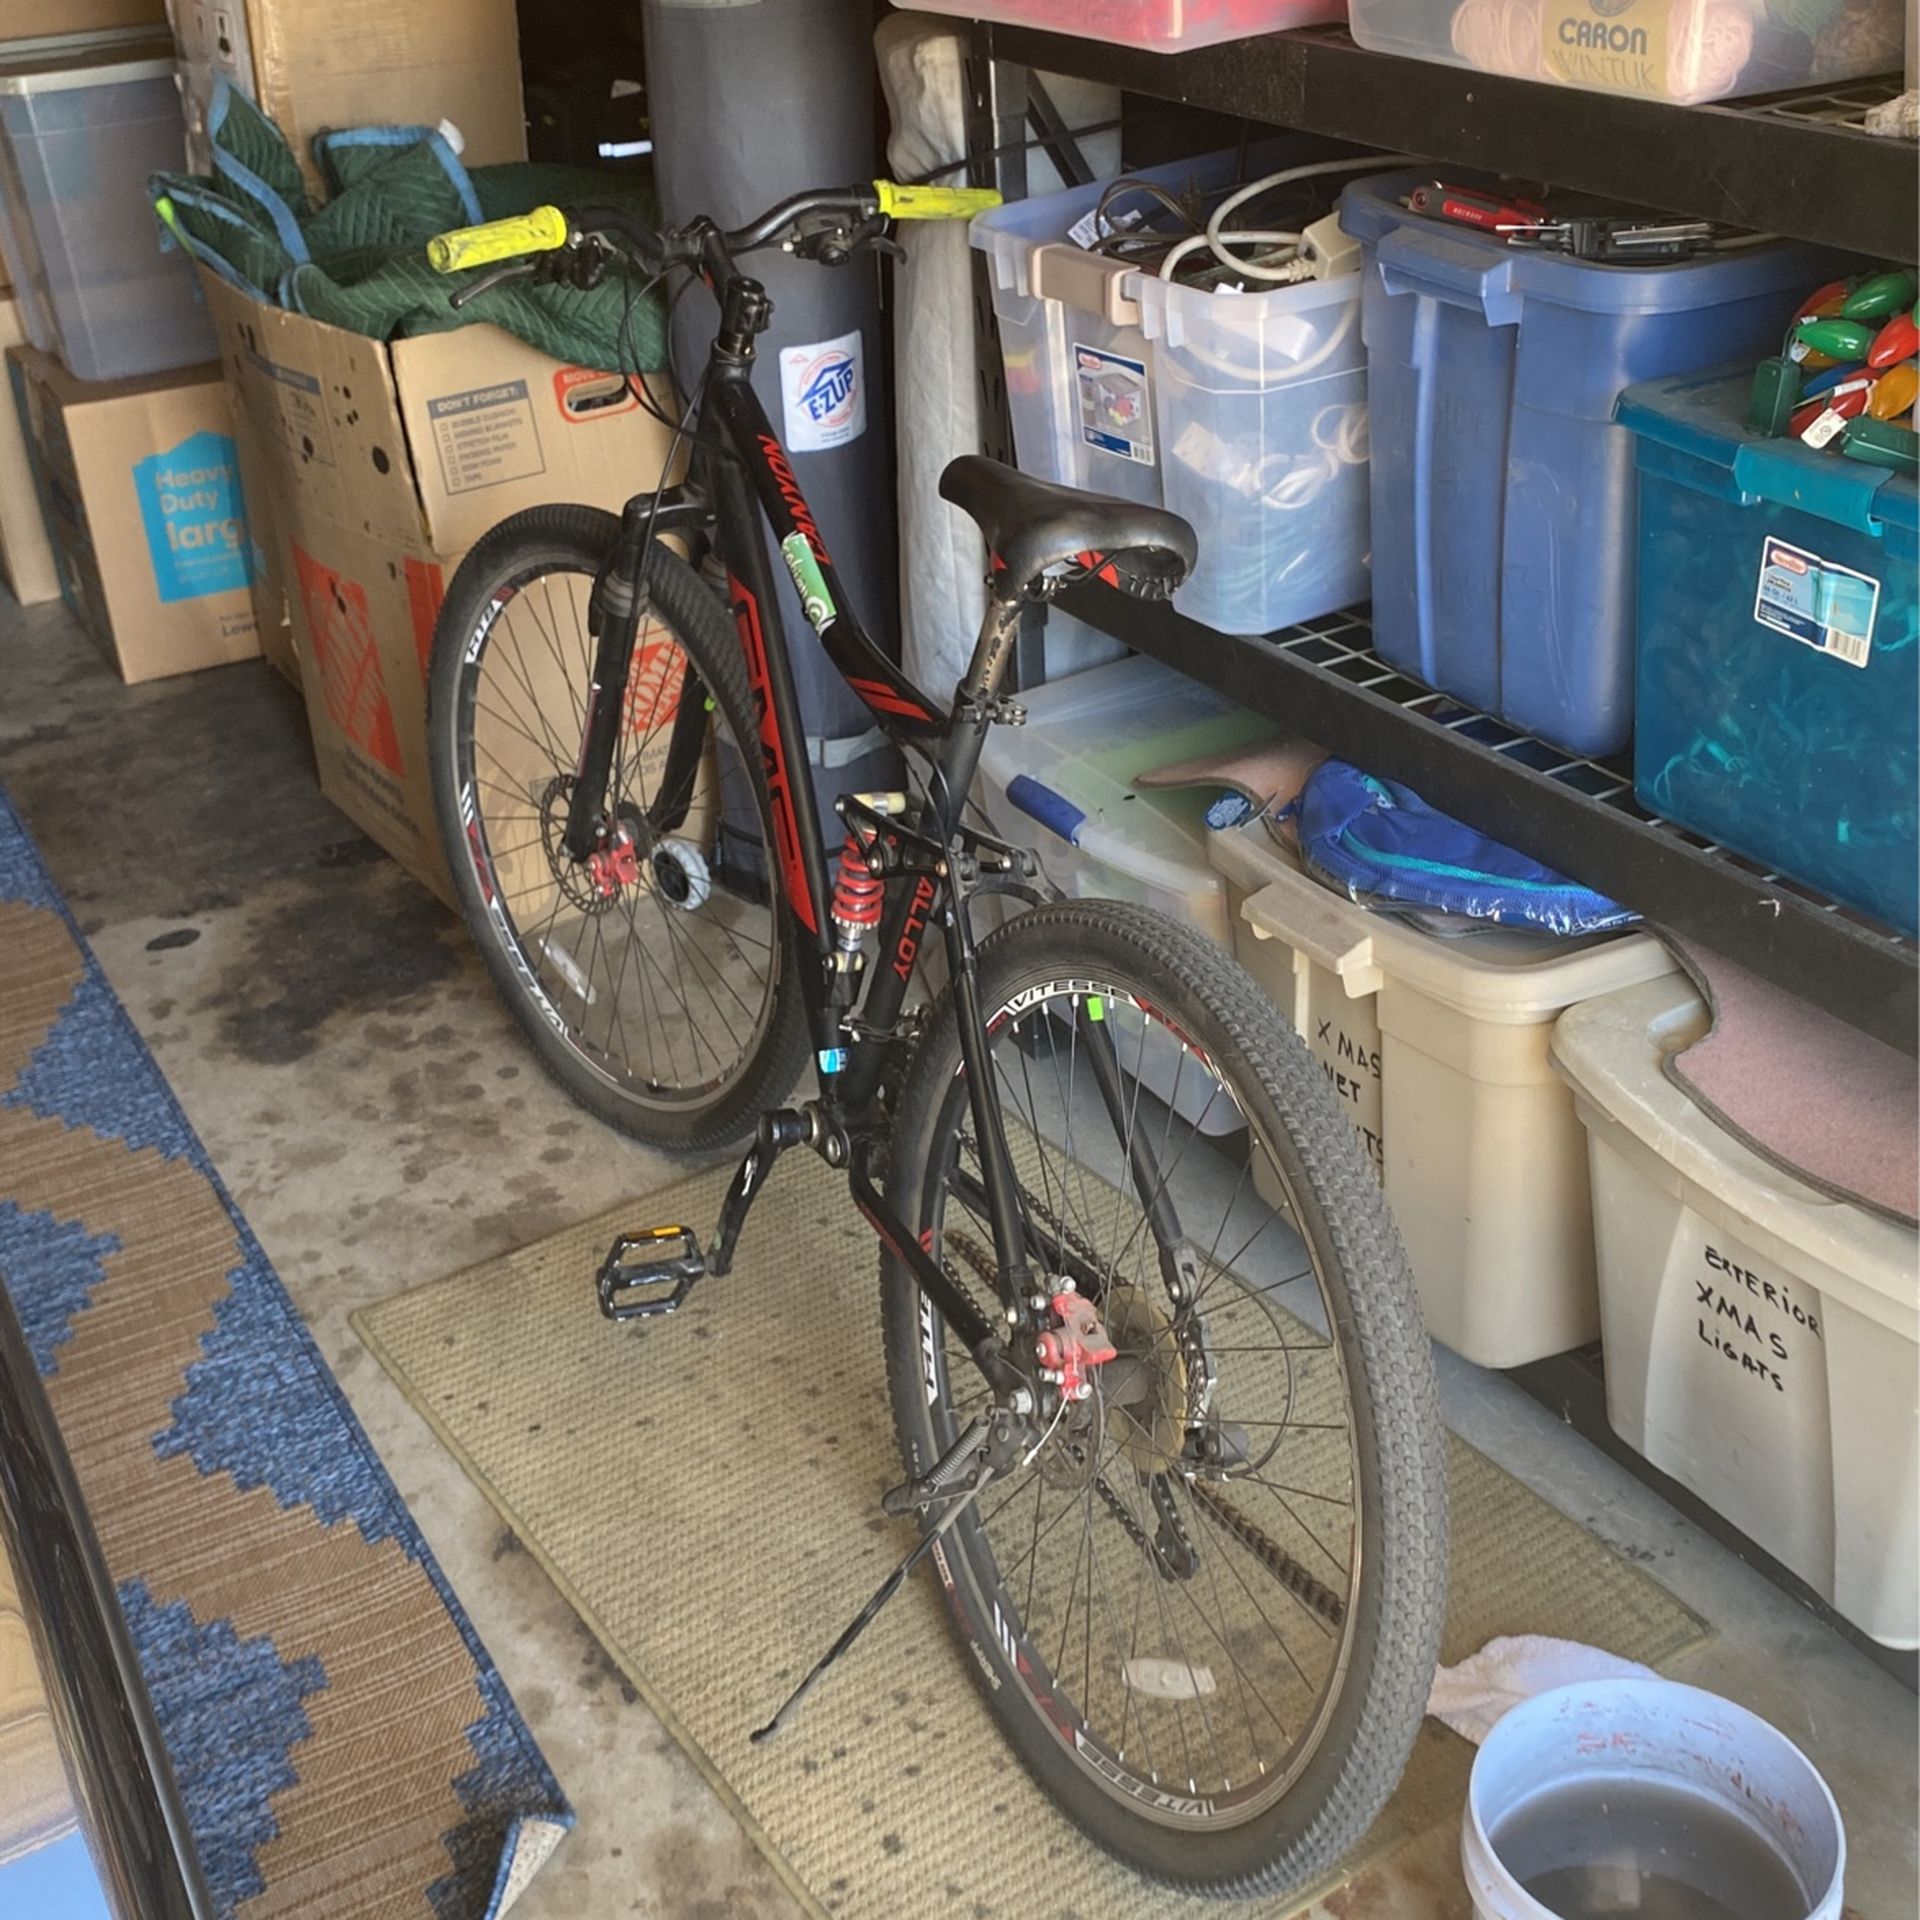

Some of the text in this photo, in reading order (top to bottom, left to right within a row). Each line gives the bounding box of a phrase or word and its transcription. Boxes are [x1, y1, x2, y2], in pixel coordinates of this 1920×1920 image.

[1558, 17, 1648, 56] CARON
[156, 464, 232, 489] Heavy
[161, 490, 218, 514] Duty
[893, 875, 934, 983] ALLOY
[1014, 980, 1131, 1007] VITESSE
[1696, 1280, 1788, 1360] XMAS
